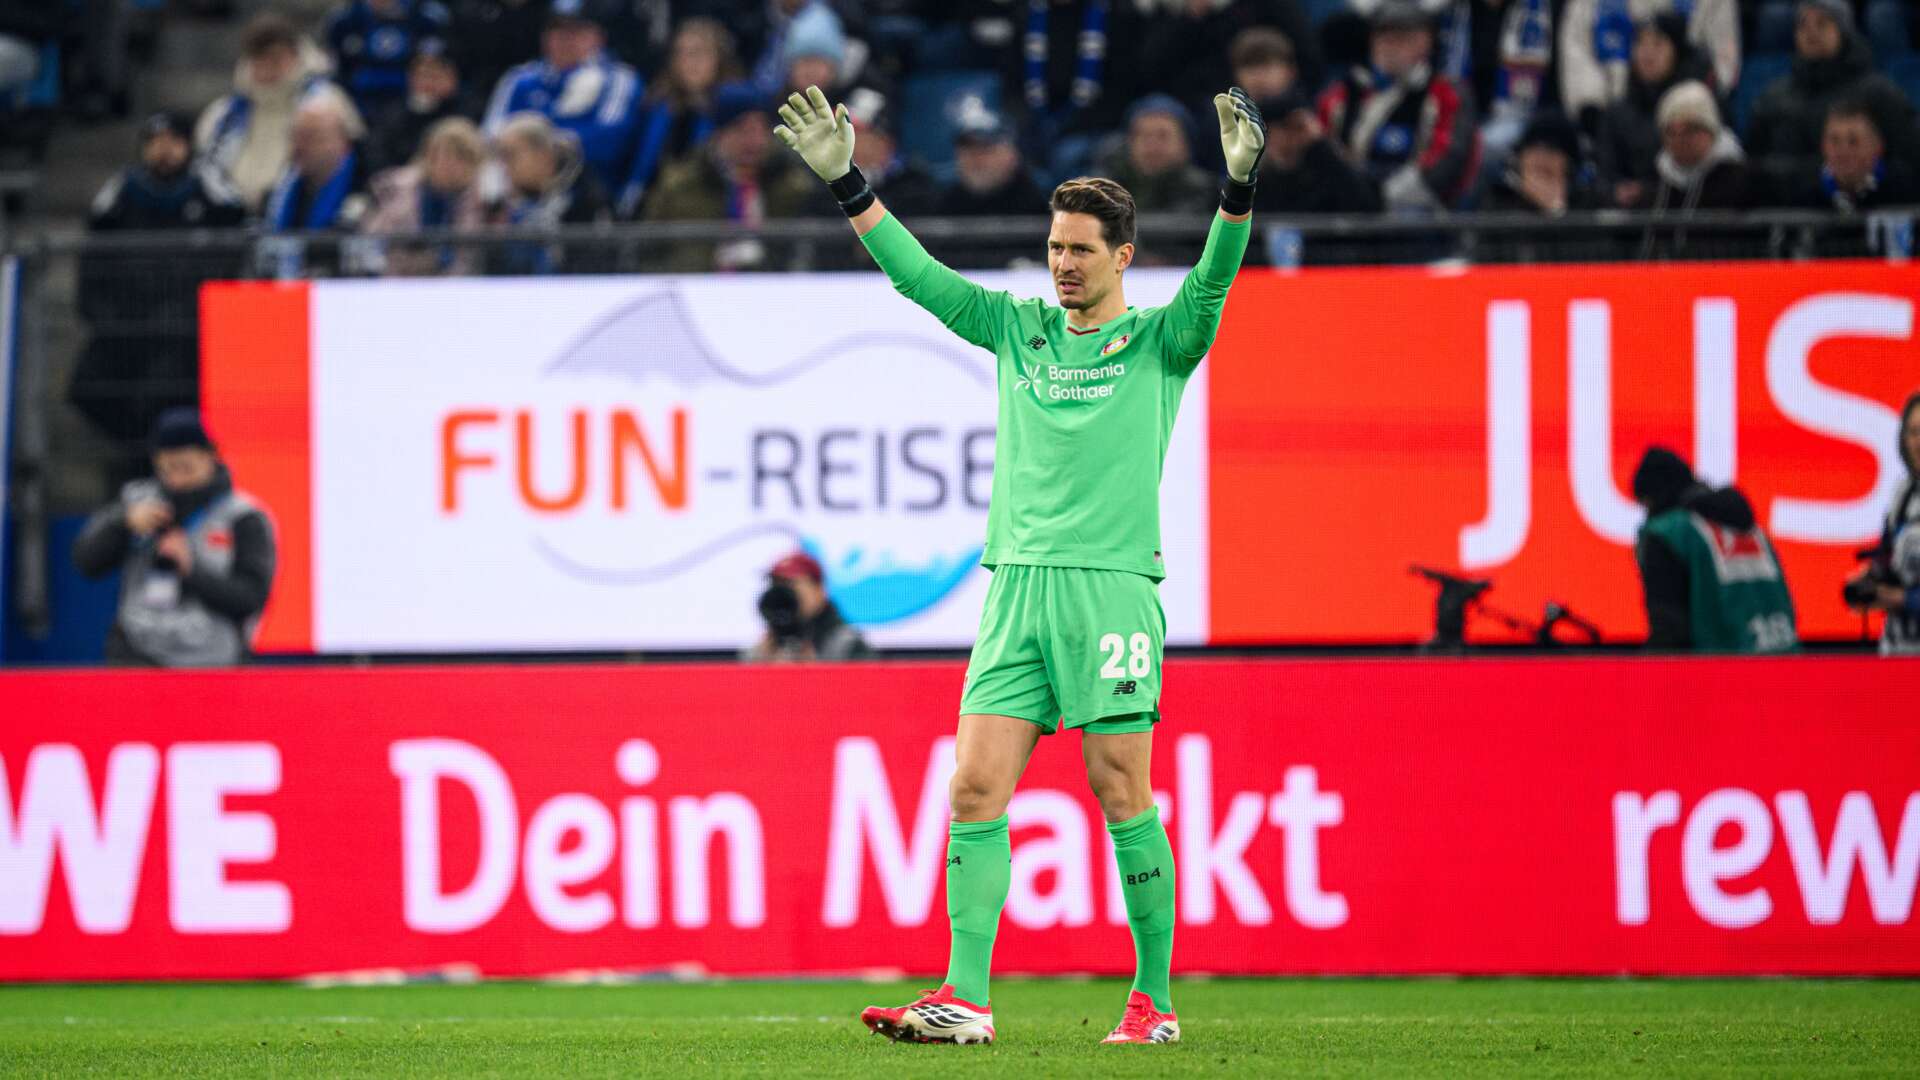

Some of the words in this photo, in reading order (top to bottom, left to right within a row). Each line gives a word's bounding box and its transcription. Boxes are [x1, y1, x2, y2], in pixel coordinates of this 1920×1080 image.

[1048, 363, 1125, 381] Barmenia
[1048, 384, 1115, 401] Gothaer
[1458, 293, 1914, 570] JUS
[1099, 632, 1151, 679] 28
[388, 738, 765, 933] Dein
[1612, 788, 1920, 929] rew
